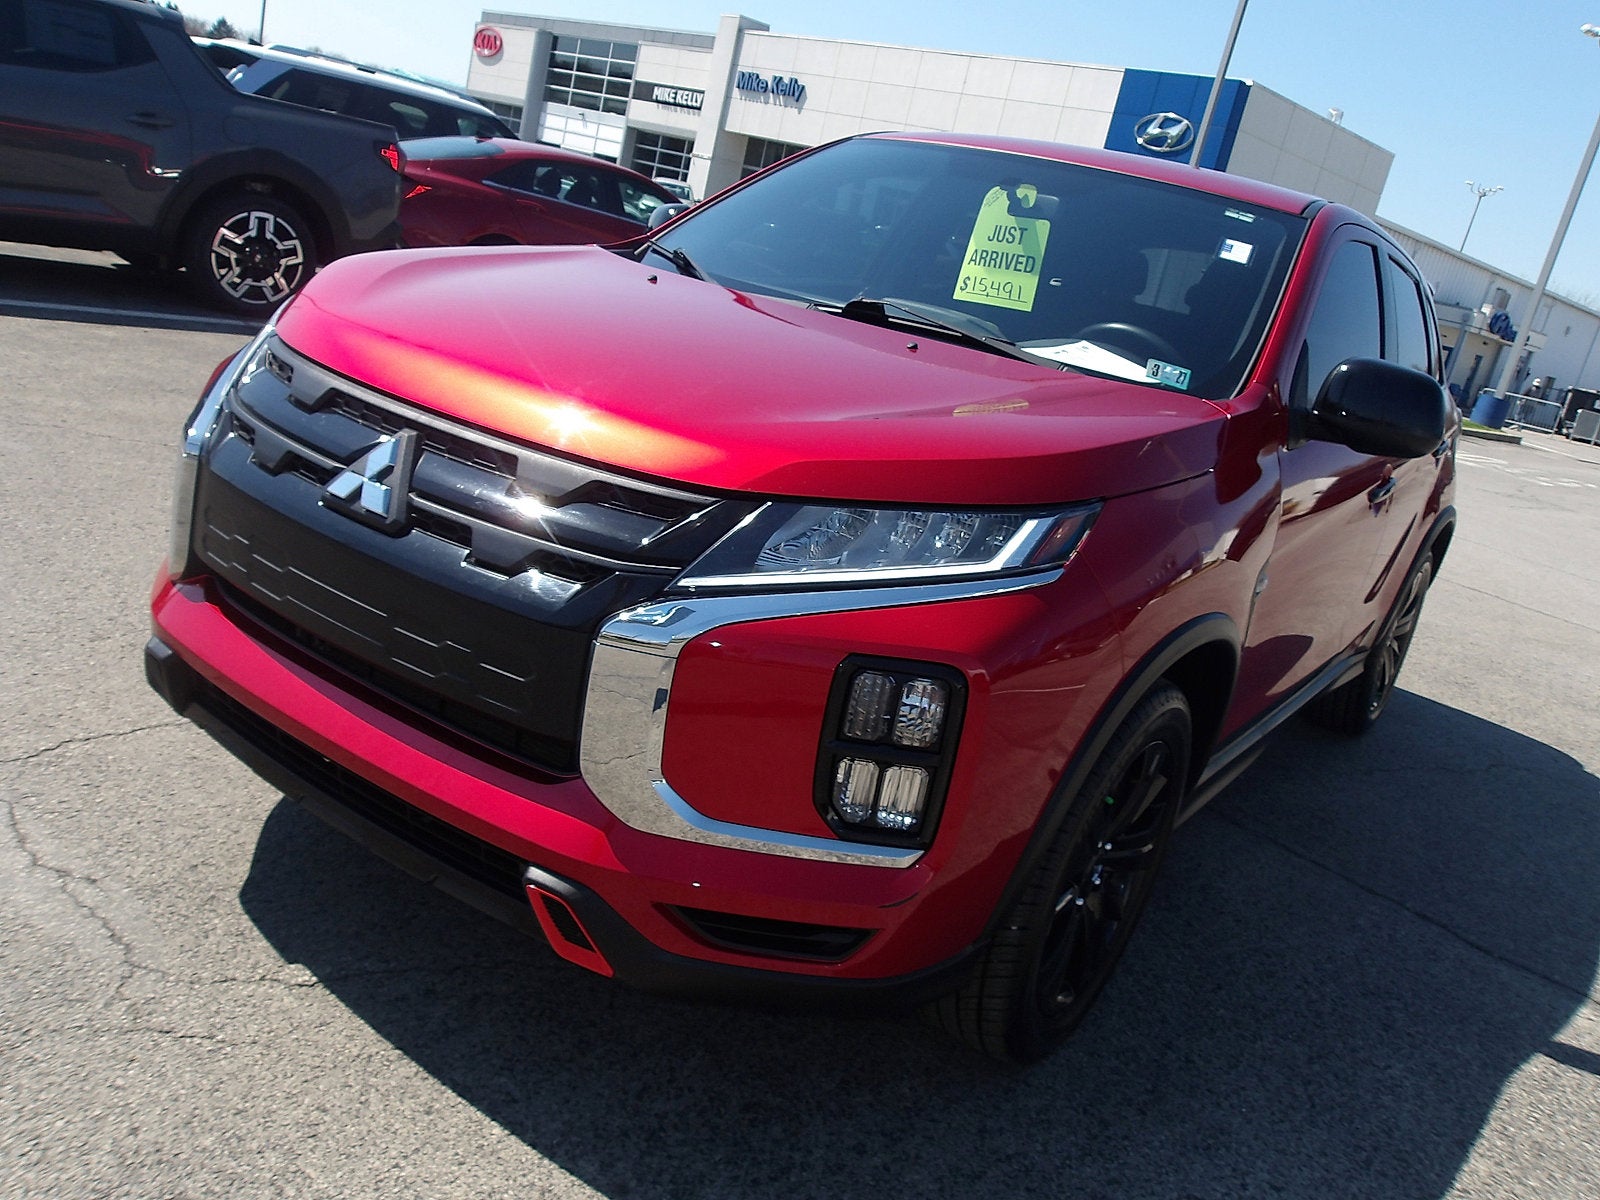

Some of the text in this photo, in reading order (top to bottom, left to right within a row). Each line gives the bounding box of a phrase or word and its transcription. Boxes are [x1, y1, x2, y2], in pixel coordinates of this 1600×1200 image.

[475, 32, 499, 51] KIA
[736, 71, 805, 102] Mike Kelly
[652, 86, 704, 109] MIKE KELLY
[987, 225, 1028, 245] JUST
[967, 249, 1036, 273] ARRIVED
[1151, 364, 1161, 377] 3
